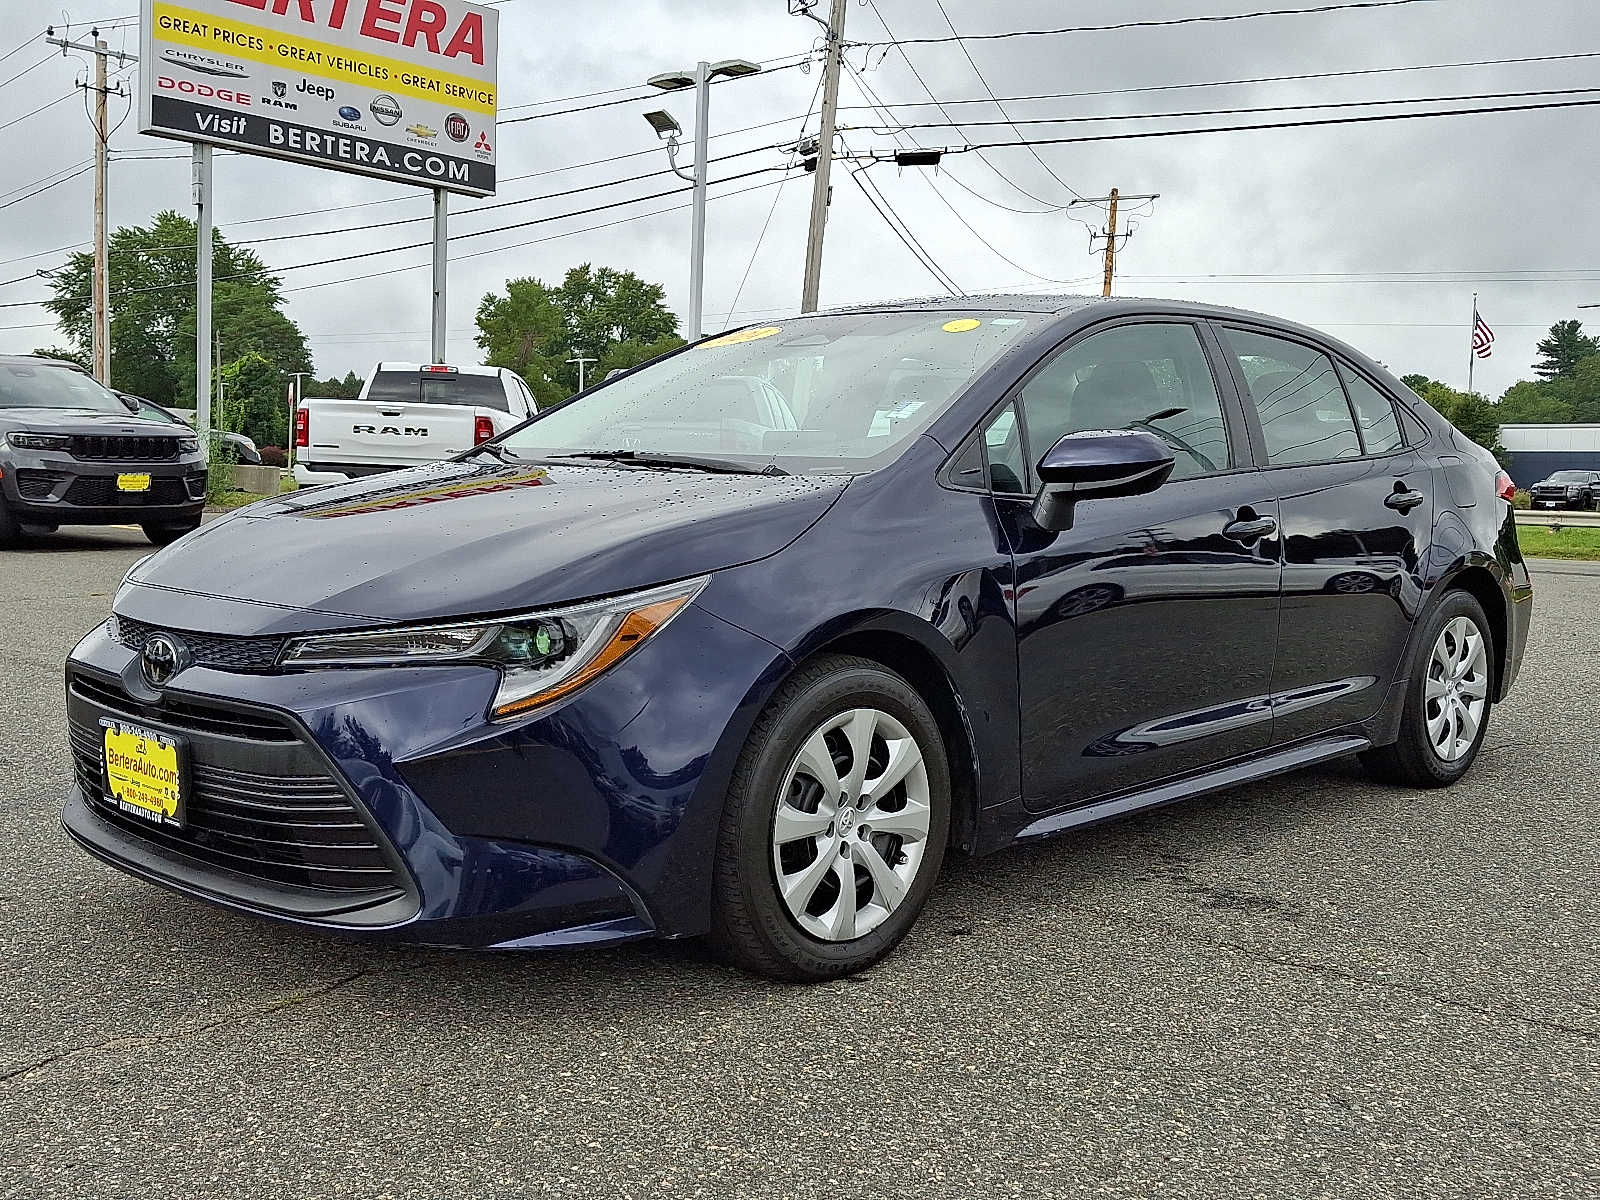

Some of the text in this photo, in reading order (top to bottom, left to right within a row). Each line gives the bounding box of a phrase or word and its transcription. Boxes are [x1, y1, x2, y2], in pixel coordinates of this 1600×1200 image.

[225, 0, 484, 65] TERA
[159, 15, 494, 105] GREAT PRICES GREAT VEHICLES GREAT SERVICE
[165, 49, 245, 71] CHRYSLER
[158, 76, 252, 106] DODGE
[296, 78, 335, 102] Jeep
[261, 97, 298, 111] RAM
[372, 105, 400, 117] NISSAN
[332, 119, 367, 132] SUBARU
[450, 120, 465, 136] FIAT
[195, 112, 469, 182] Visit BERTERA.COM
[353, 425, 428, 437] RAM
[108, 747, 177, 786] BerteraAuto.com
